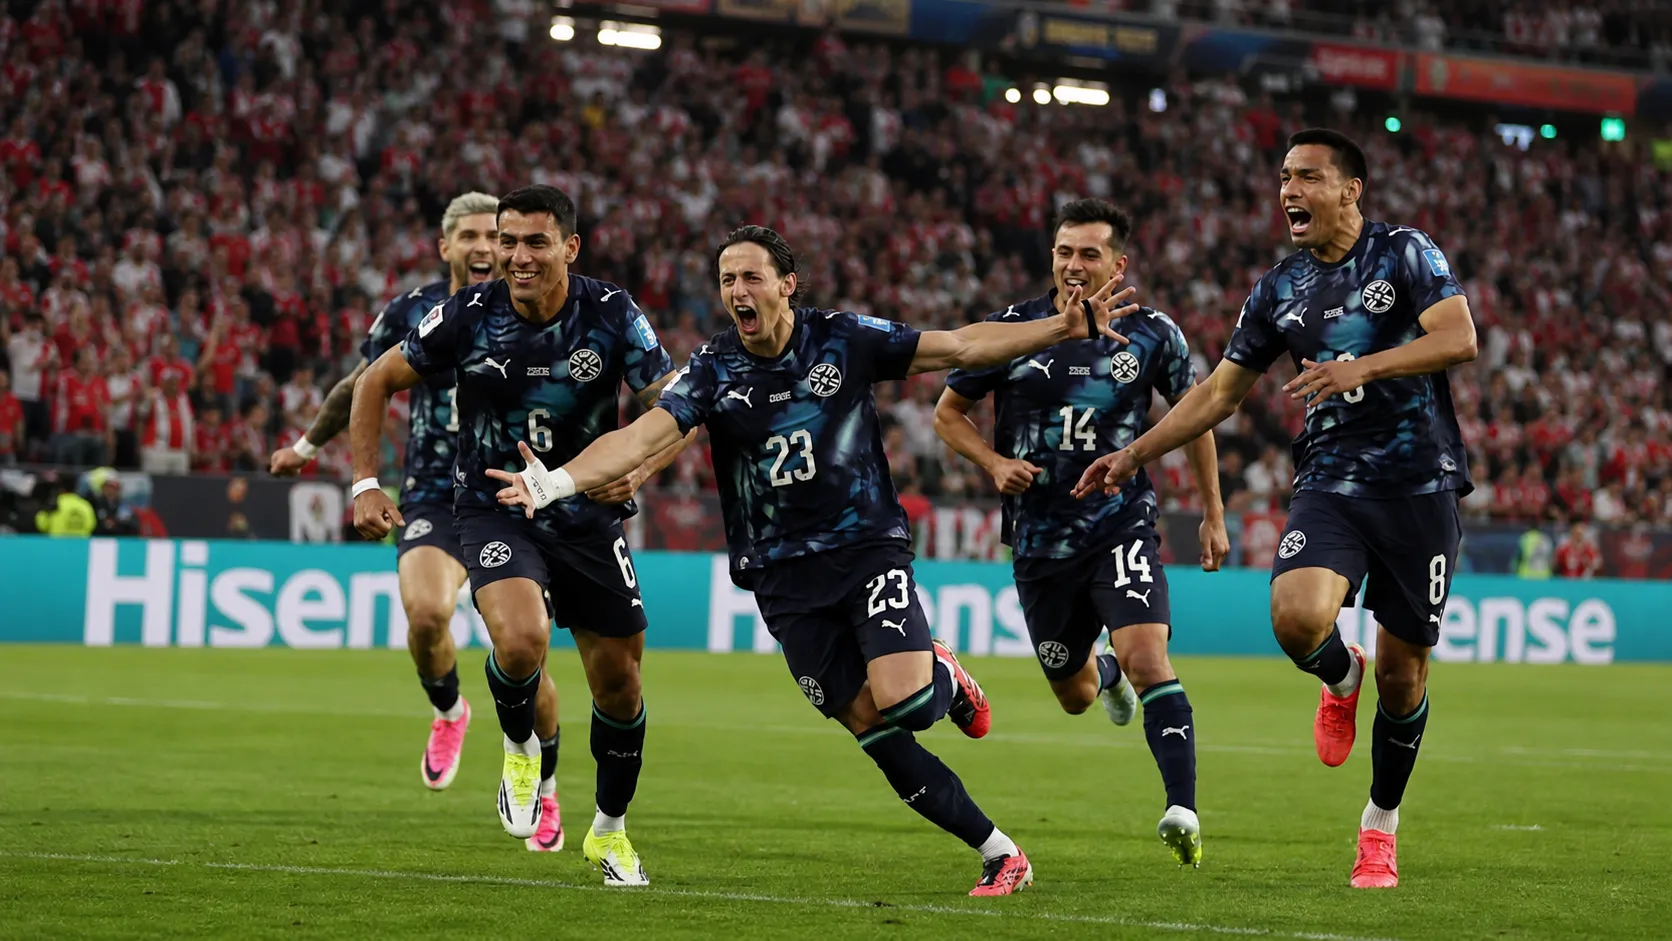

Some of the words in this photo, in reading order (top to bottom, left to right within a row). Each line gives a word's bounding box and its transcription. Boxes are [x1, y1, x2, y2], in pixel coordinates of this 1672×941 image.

[528, 408, 553, 452] 6
[1059, 406, 1096, 451] 14
[766, 428, 817, 487] 23
[613, 536, 636, 589] 6
[1111, 538, 1154, 588] 14
[1429, 553, 1446, 606] 8
[84, 539, 496, 651] Hisen
[866, 568, 910, 619] 23
